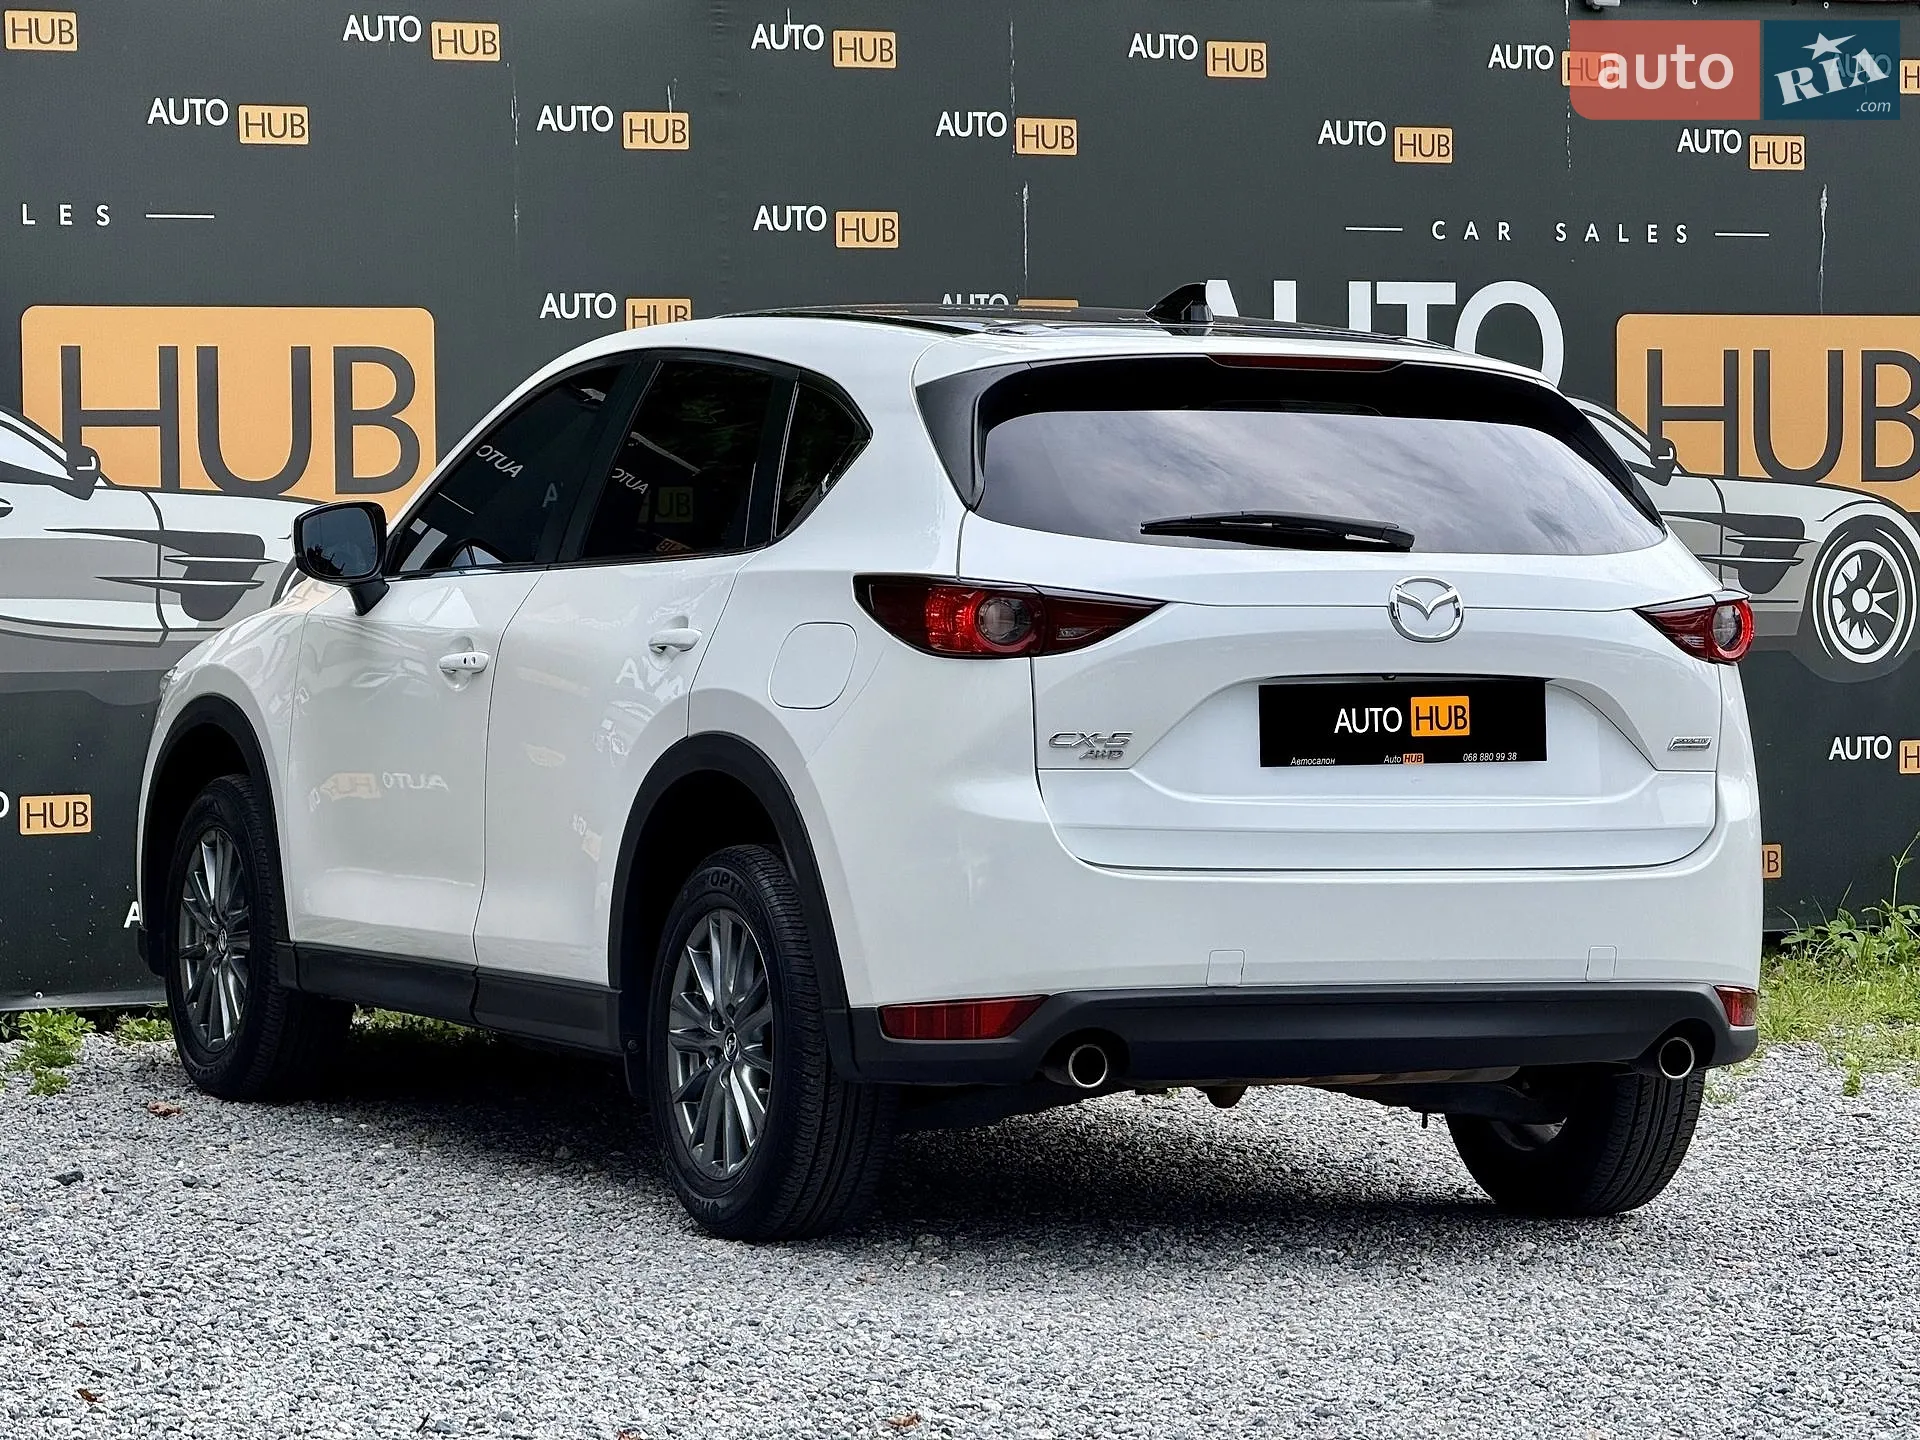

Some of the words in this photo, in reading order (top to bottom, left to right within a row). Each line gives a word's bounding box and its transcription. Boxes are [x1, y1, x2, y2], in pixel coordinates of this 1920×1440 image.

[11, 18, 74, 45] HUB
[343, 15, 421, 42] AUTO
[437, 29, 498, 56] HUB
[751, 23, 824, 50] AUTO
[838, 37, 895, 63] HUB
[1129, 33, 1198, 60] AUTO
[1212, 48, 1265, 73] HUB
[1488, 44, 1554, 70] AUTO
[148, 98, 228, 126] AUTO
[244, 112, 306, 139] HUB
[537, 105, 613, 132] AUTO
[629, 119, 687, 145] HUB
[936, 112, 1007, 138] AUTO
[1021, 124, 1075, 150] HUB
[1318, 120, 1386, 147] AUTO
[1399, 133, 1451, 159] HUB
[1677, 129, 1742, 154] AUTO
[1754, 142, 1803, 166] HUB
[753, 205, 826, 232] AUTO
[841, 218, 896, 243] HUB
[1432, 220, 1511, 241] CAR
[1555, 223, 1688, 244] SALES
[540, 293, 616, 319] AUTO
[632, 305, 688, 329] HUB
[60, 346, 422, 496] HUB
[1334, 707, 1403, 733] AUTO
[1415, 705, 1468, 731] HUB
[1048, 731, 1134, 749] CX-5
[1462, 753, 1478, 762] 068
[1479, 753, 1495, 762] 880
[1495, 753, 1506, 761] 99
[1829, 736, 1892, 760] AUTO
[1290, 757, 1336, 766] Автосалон
[1383, 755, 1402, 764] Auto
[1404, 754, 1423, 763] HUB
[26, 801, 89, 829] HUB
